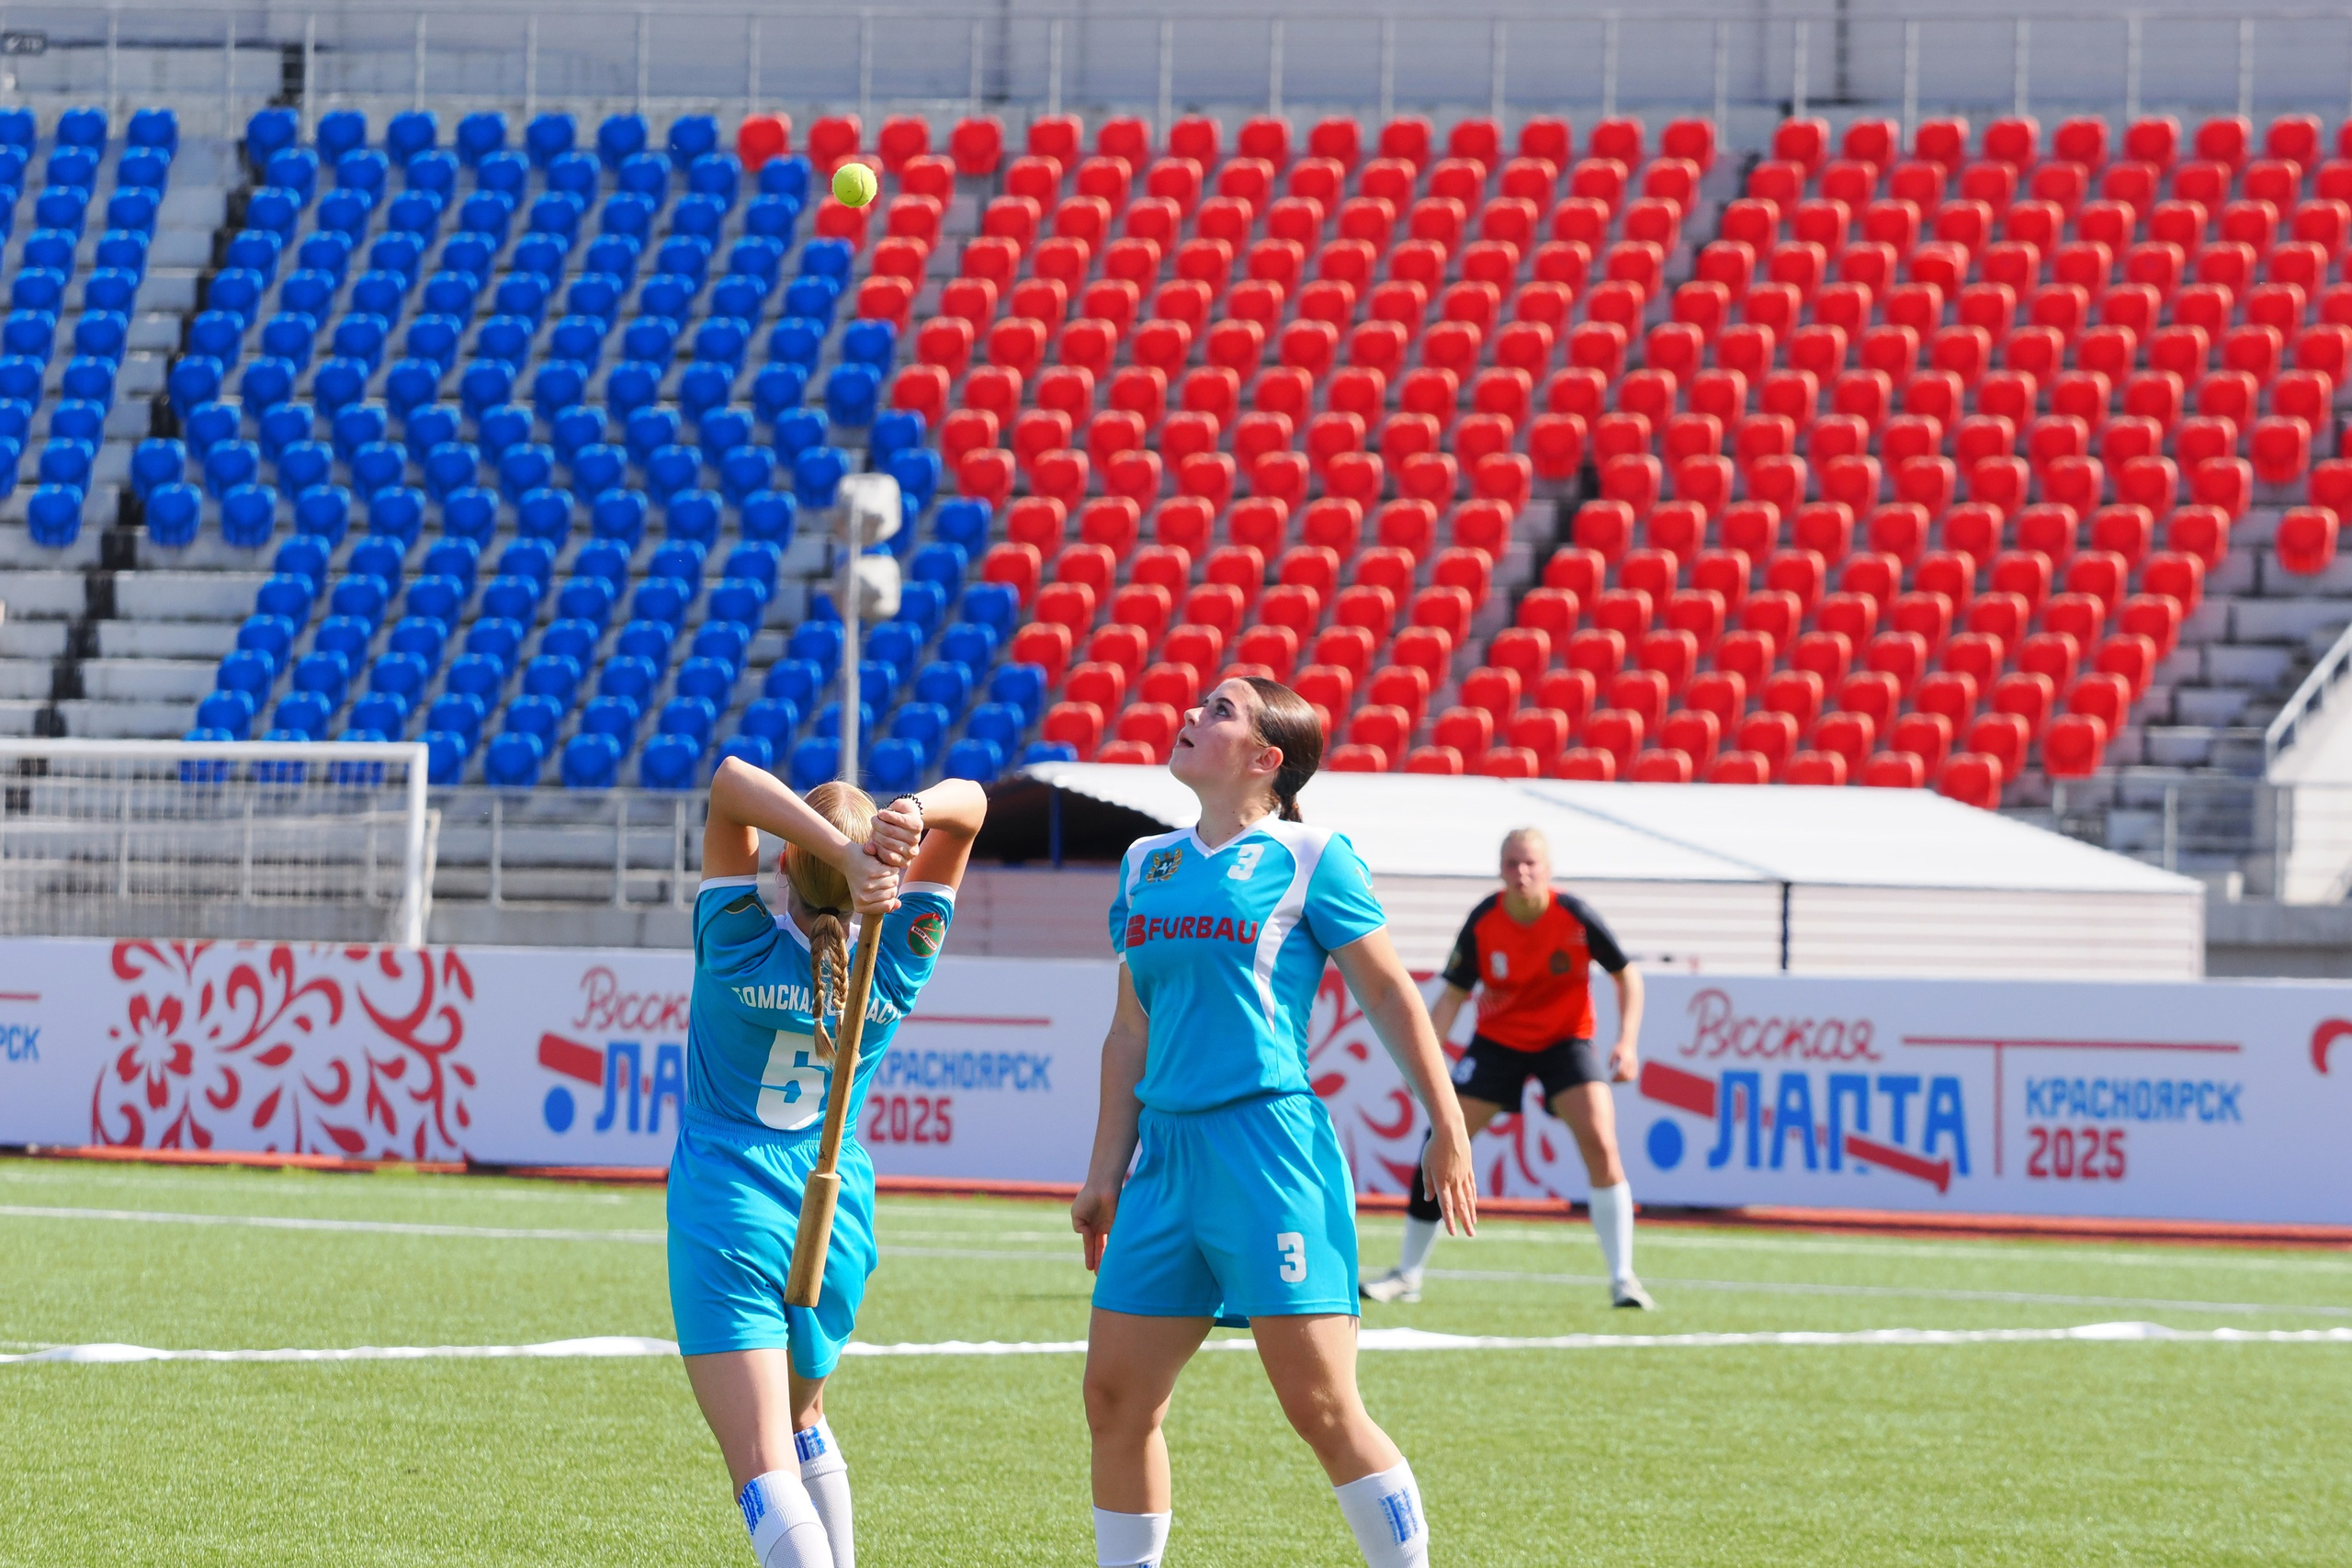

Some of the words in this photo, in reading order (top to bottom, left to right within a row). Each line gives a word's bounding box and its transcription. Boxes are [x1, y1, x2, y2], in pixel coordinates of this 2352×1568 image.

[1227, 843, 1265, 881] 3
[1148, 916, 1259, 945] FURBAU
[573, 966, 691, 1032] Русск
[731, 984, 814, 1013] ТОМСКА
[595, 1040, 688, 1135] ЛА
[756, 1029, 838, 1131] 5
[2026, 1077, 2243, 1123] КРАСНОЯРСК
[869, 1095, 952, 1142] 2025
[1707, 1069, 1971, 1177] ЛАПТА
[2027, 1126, 2126, 1179] 2025
[1276, 1231, 1307, 1283] 3
